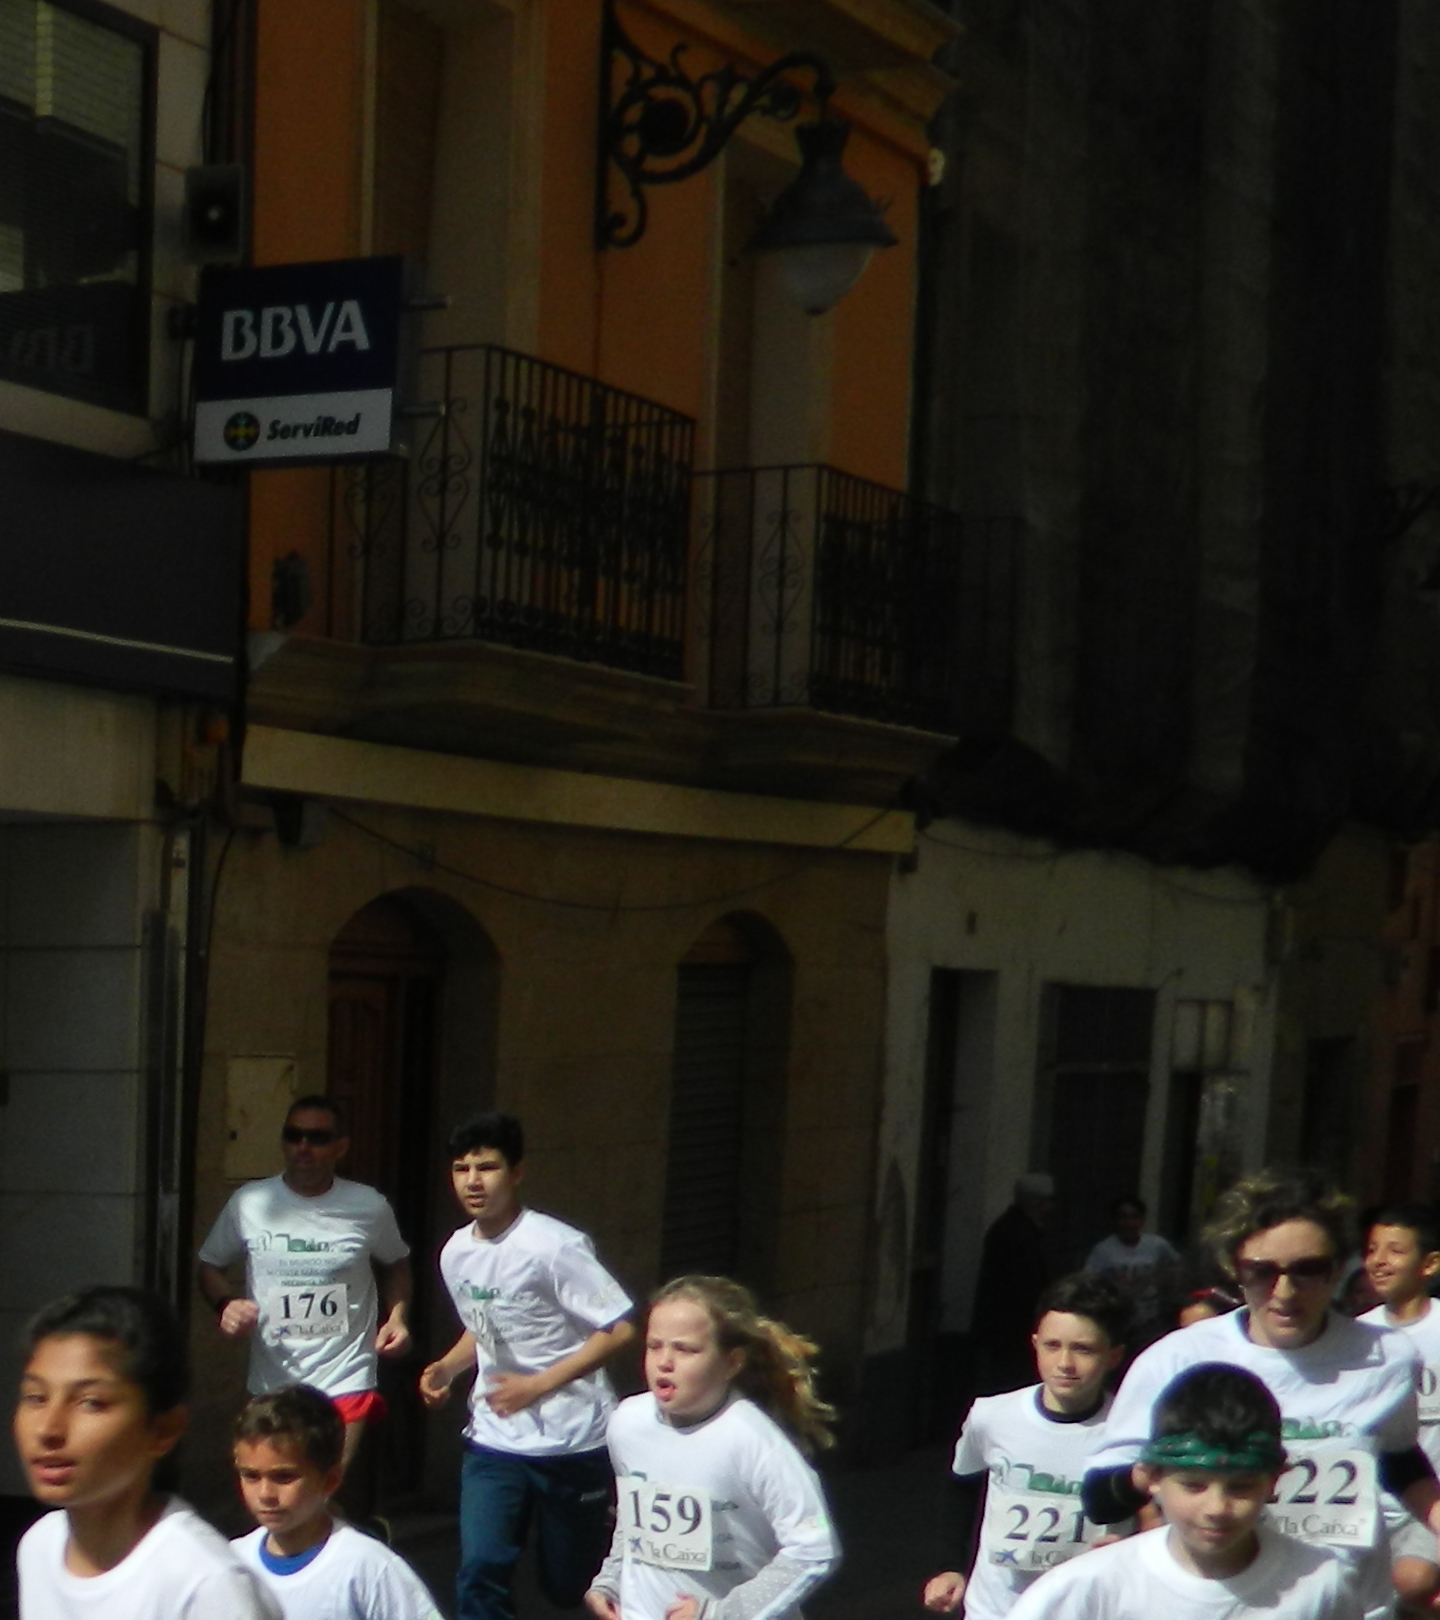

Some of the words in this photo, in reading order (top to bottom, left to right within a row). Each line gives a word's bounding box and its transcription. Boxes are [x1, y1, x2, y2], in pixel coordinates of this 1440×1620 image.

[221, 299, 370, 361] BBVA
[267, 412, 361, 441] ServiRed
[280, 1290, 338, 1319] 176
[1264, 1458, 1359, 1505] 22
[630, 1490, 702, 1536] 159
[1004, 1503, 1088, 1544] 221
